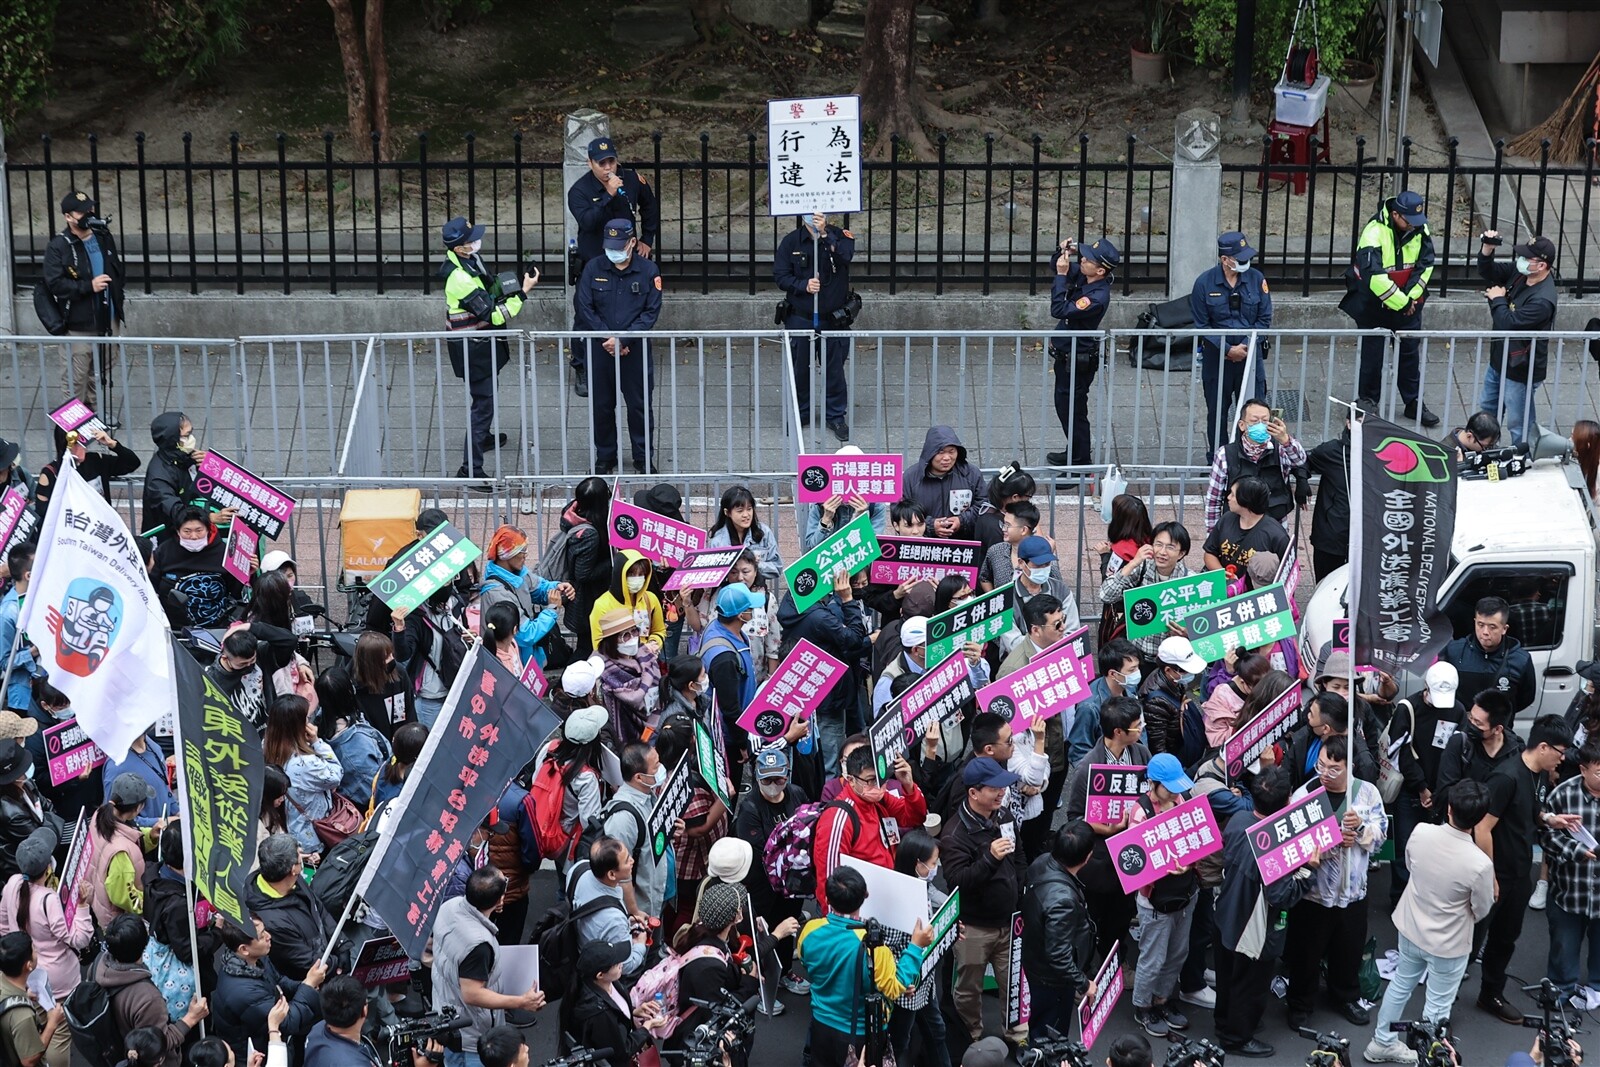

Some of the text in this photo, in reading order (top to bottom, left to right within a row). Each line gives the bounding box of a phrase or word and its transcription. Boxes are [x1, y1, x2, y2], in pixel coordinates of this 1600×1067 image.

[790, 102, 839, 119] 警告
[779, 161, 852, 187] 違法
[831, 461, 896, 477] 市場要自由
[831, 479, 896, 495] 國人要尊重
[221, 467, 288, 516] 保留市場競爭力
[642, 518, 698, 550] 市場要自由
[1422, 491, 1437, 552] NATIONAL
[79, 540, 109, 562] Taiwan
[109, 558, 139, 588] Delivery
[397, 532, 454, 581] 反併購
[639, 534, 688, 562] 國人要尊
[816, 528, 862, 570] 公平會
[899, 544, 973, 564] 拒絕附條件合併
[952, 594, 1005, 632] 反併購
[1159, 580, 1214, 607] 公平會
[1216, 592, 1278, 629] 反併購
[952, 615, 1003, 650] 要競爭
[1220, 616, 1283, 650] 要競爭
[766, 650, 818, 707] 市場要自由
[782, 660, 836, 718] 國人要尊重
[906, 659, 963, 715] 保留市場競爭力
[1010, 657, 1074, 699] 市場要自由
[1018, 674, 1082, 720] 國人要尊重
[1142, 806, 1207, 848] 市場要自由
[1274, 799, 1324, 843] 反壟斷
[1149, 825, 1215, 870] 國人要尊重
[1282, 825, 1333, 868] 拒獨佔
